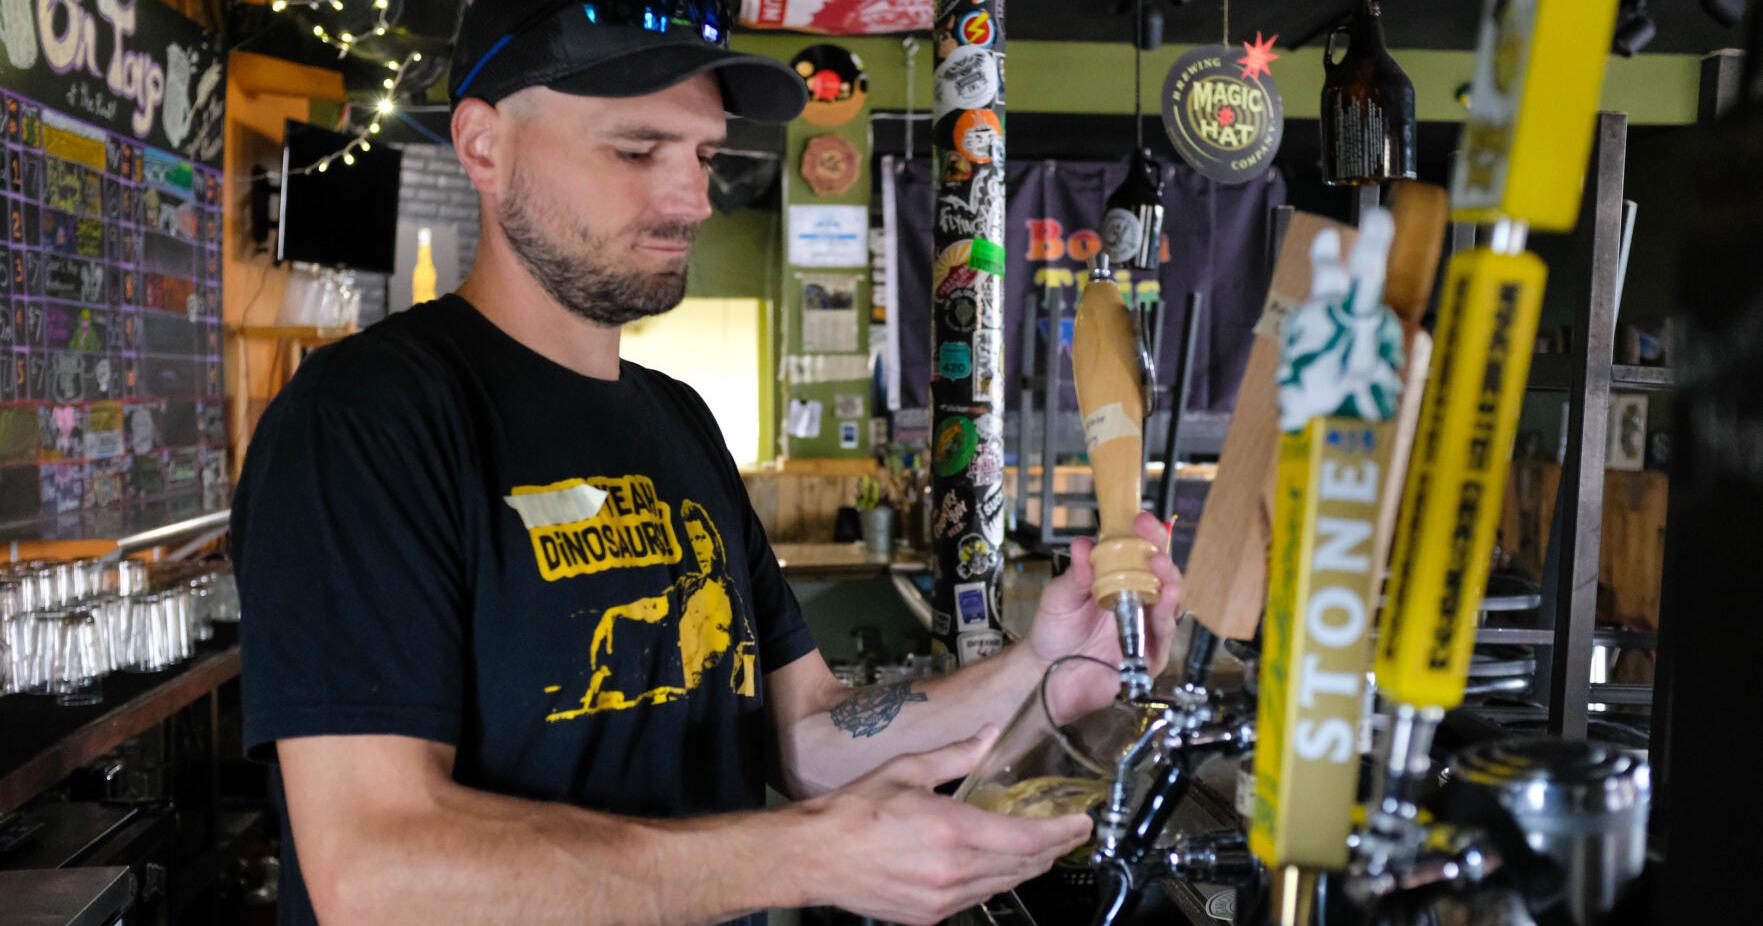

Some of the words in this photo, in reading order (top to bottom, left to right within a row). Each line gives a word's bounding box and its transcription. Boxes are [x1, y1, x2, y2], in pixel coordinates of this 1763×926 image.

[37, 0, 103, 75] On
[96, 0, 165, 139] Tap
[1172, 57, 1222, 101] BREWING
[1192, 81, 1262, 112] MAGIC
[1200, 119, 1253, 146] HAT
[1230, 121, 1276, 170] COMPANY
[1025, 218, 1171, 263] Bo
[1292, 457, 1381, 766] STONE
